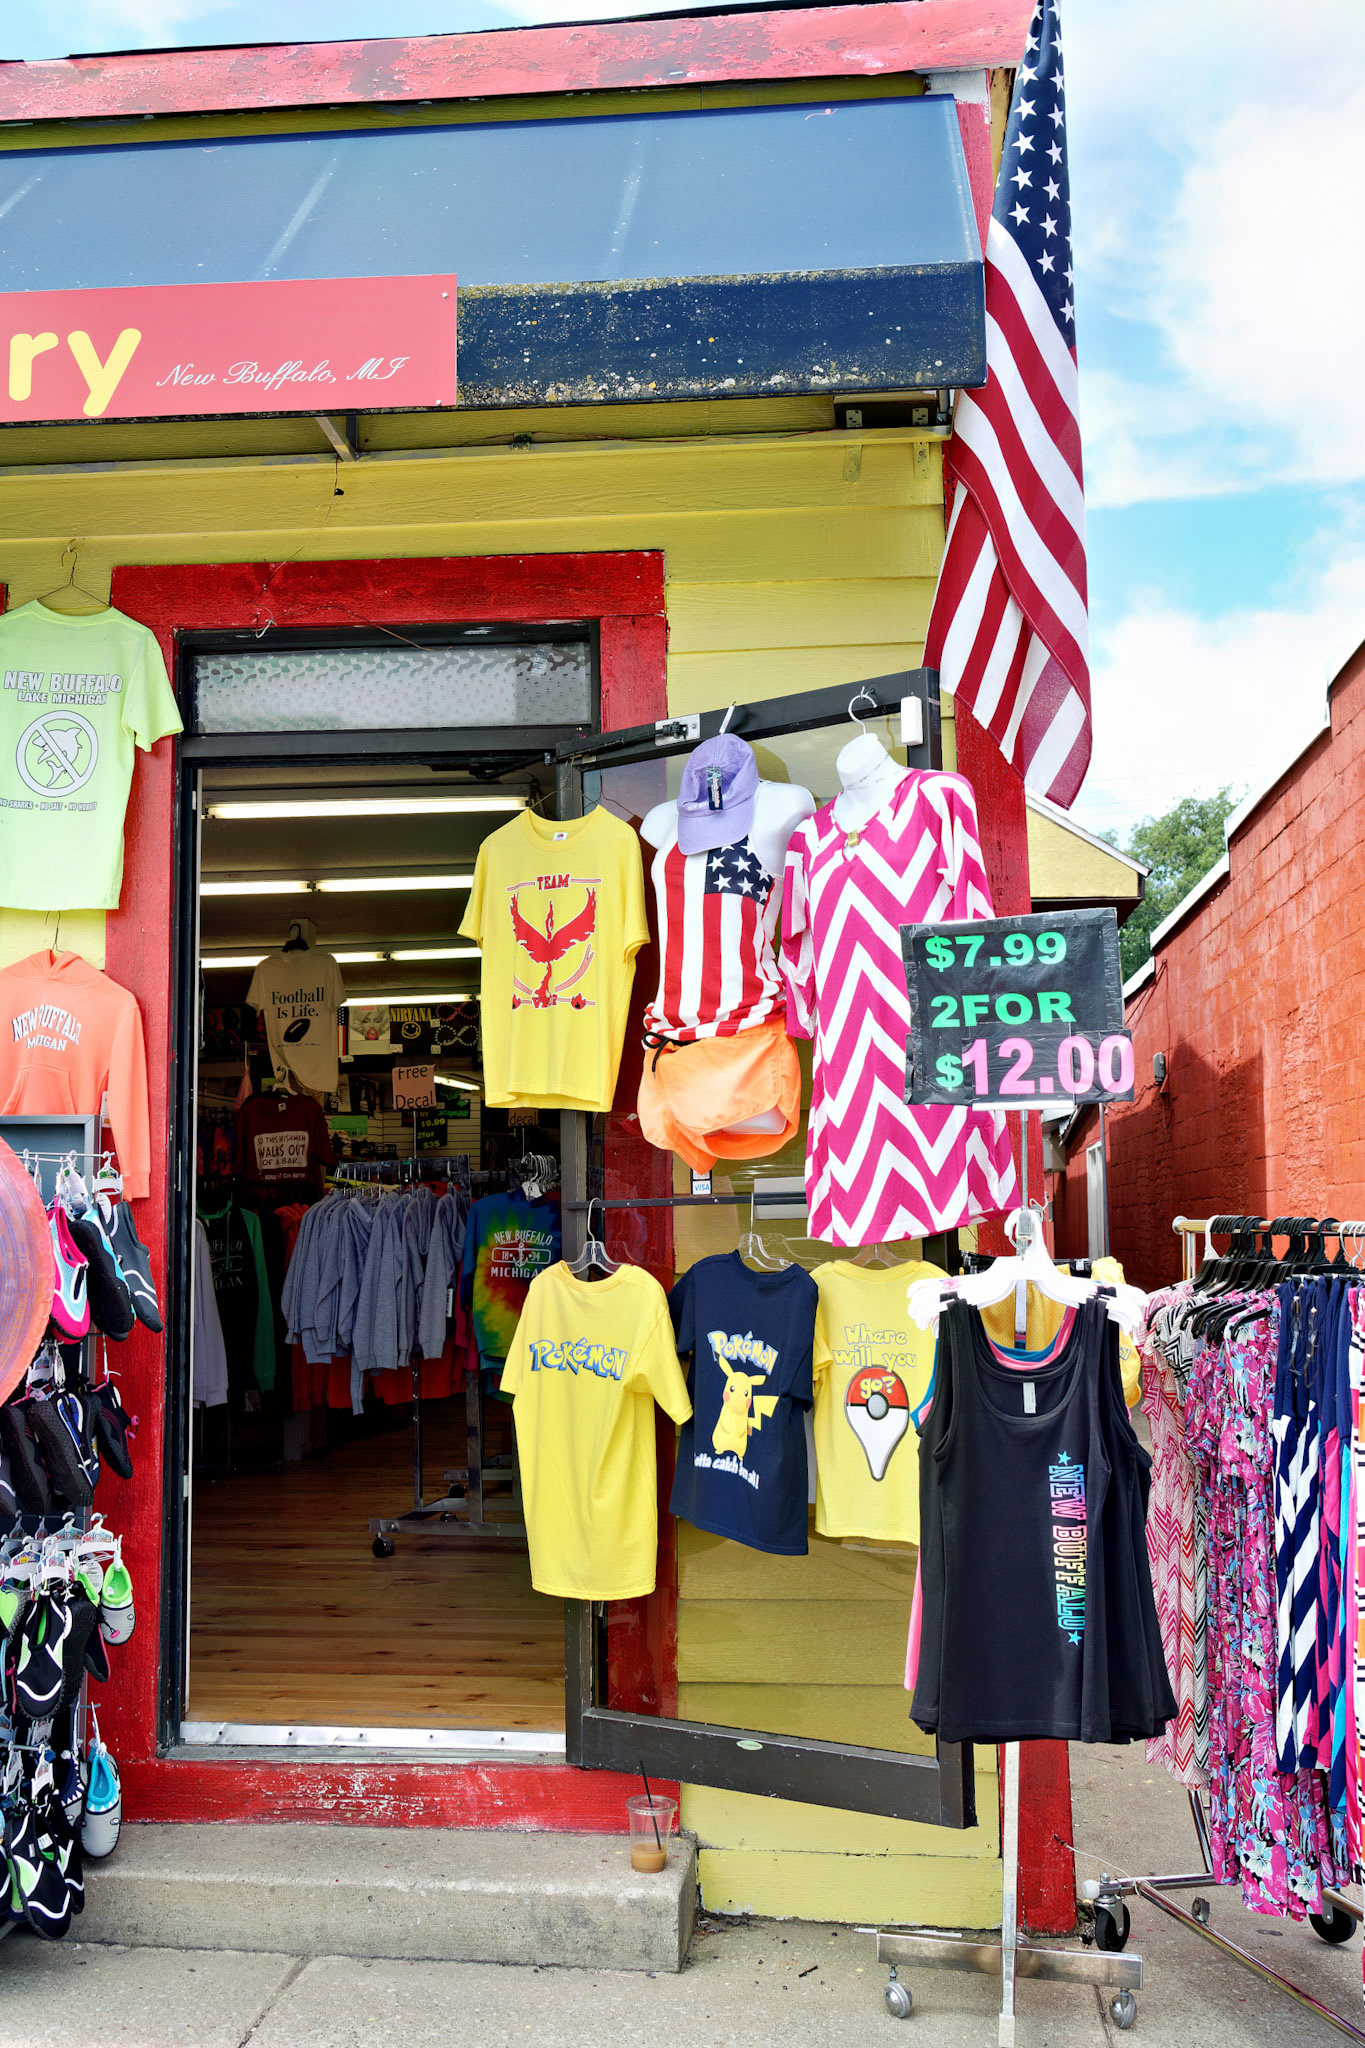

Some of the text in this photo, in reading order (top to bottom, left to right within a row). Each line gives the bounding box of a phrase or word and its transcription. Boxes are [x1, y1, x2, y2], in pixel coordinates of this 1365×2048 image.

[8, 328, 142, 417] ry
[155, 363, 217, 387] New
[222, 359, 337, 391] Buffalo,
[3, 670, 45, 692] NEW
[17, 691, 49, 704] LAKE
[8, 800, 34, 811] SHARKS
[49, 802, 64, 811] SALT
[68, 802, 77, 811] NO
[536, 873, 570, 891] TEAM
[925, 931, 1068, 973] $7.99
[271, 986, 325, 1006] Football
[277, 1004, 319, 1019] Is Life.
[390, 1007, 432, 1023] NIRVANA
[11, 1006, 38, 1043] NEW
[397, 1065, 428, 1081] Free
[935, 1034, 1135, 1097] $12.00
[395, 1091, 435, 1109] Decal
[509, 1111, 538, 1125] decal
[265, 1136, 277, 1144] THIS
[258, 1144, 306, 1159] WALKS OUT
[694, 1183, 710, 1192] VISA
[494, 1230, 512, 1244] NEW
[514, 1229, 553, 1246] BUFFALO
[490, 1266, 545, 1278] MICHIGA
[843, 1323, 908, 1346] Where
[832, 1345, 917, 1374] will you
[860, 1374, 897, 1400] go?
[693, 1452, 712, 1469] otta
[712, 1455, 739, 1474] catch
[1048, 1463, 1088, 1521] NEW
